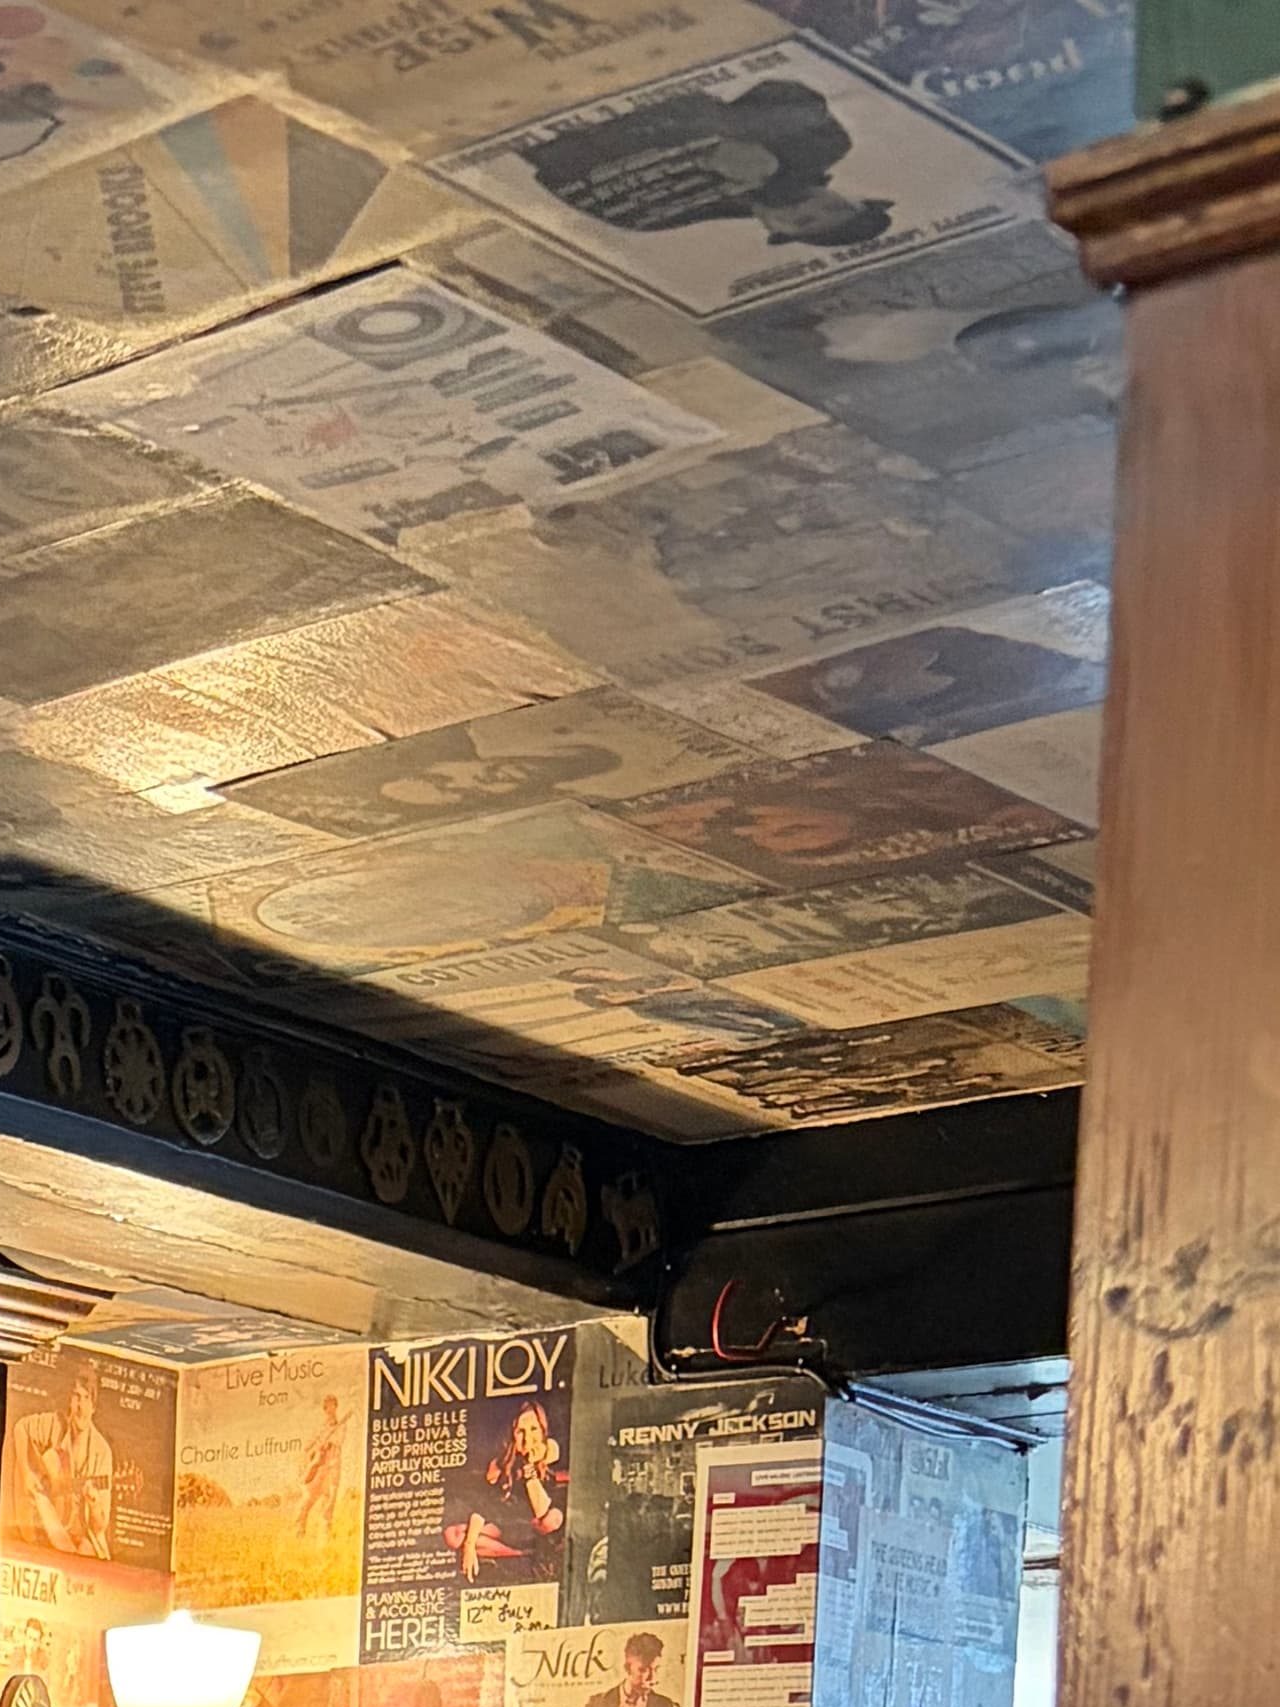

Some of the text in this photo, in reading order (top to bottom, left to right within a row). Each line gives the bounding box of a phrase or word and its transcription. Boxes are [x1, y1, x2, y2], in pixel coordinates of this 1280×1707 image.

[226, 1359, 325, 1389] Live Music
[373, 1346, 476, 1410] NIKKI
[259, 1391, 288, 1406] from
[372, 1409, 467, 1432] BLUES BELLE
[372, 1424, 467, 1446] SOUL DIVA &
[180, 1442, 239, 1465] Charlie
[372, 1438, 467, 1460] POP PRINCESS
[371, 1453, 467, 1475] ARTFULLY ROLLED
[370, 1470, 445, 1488] INTO ONE.
[366, 1587, 445, 1606] PLAYING LIVE
[366, 1601, 445, 1619] & ACOUSTIC
